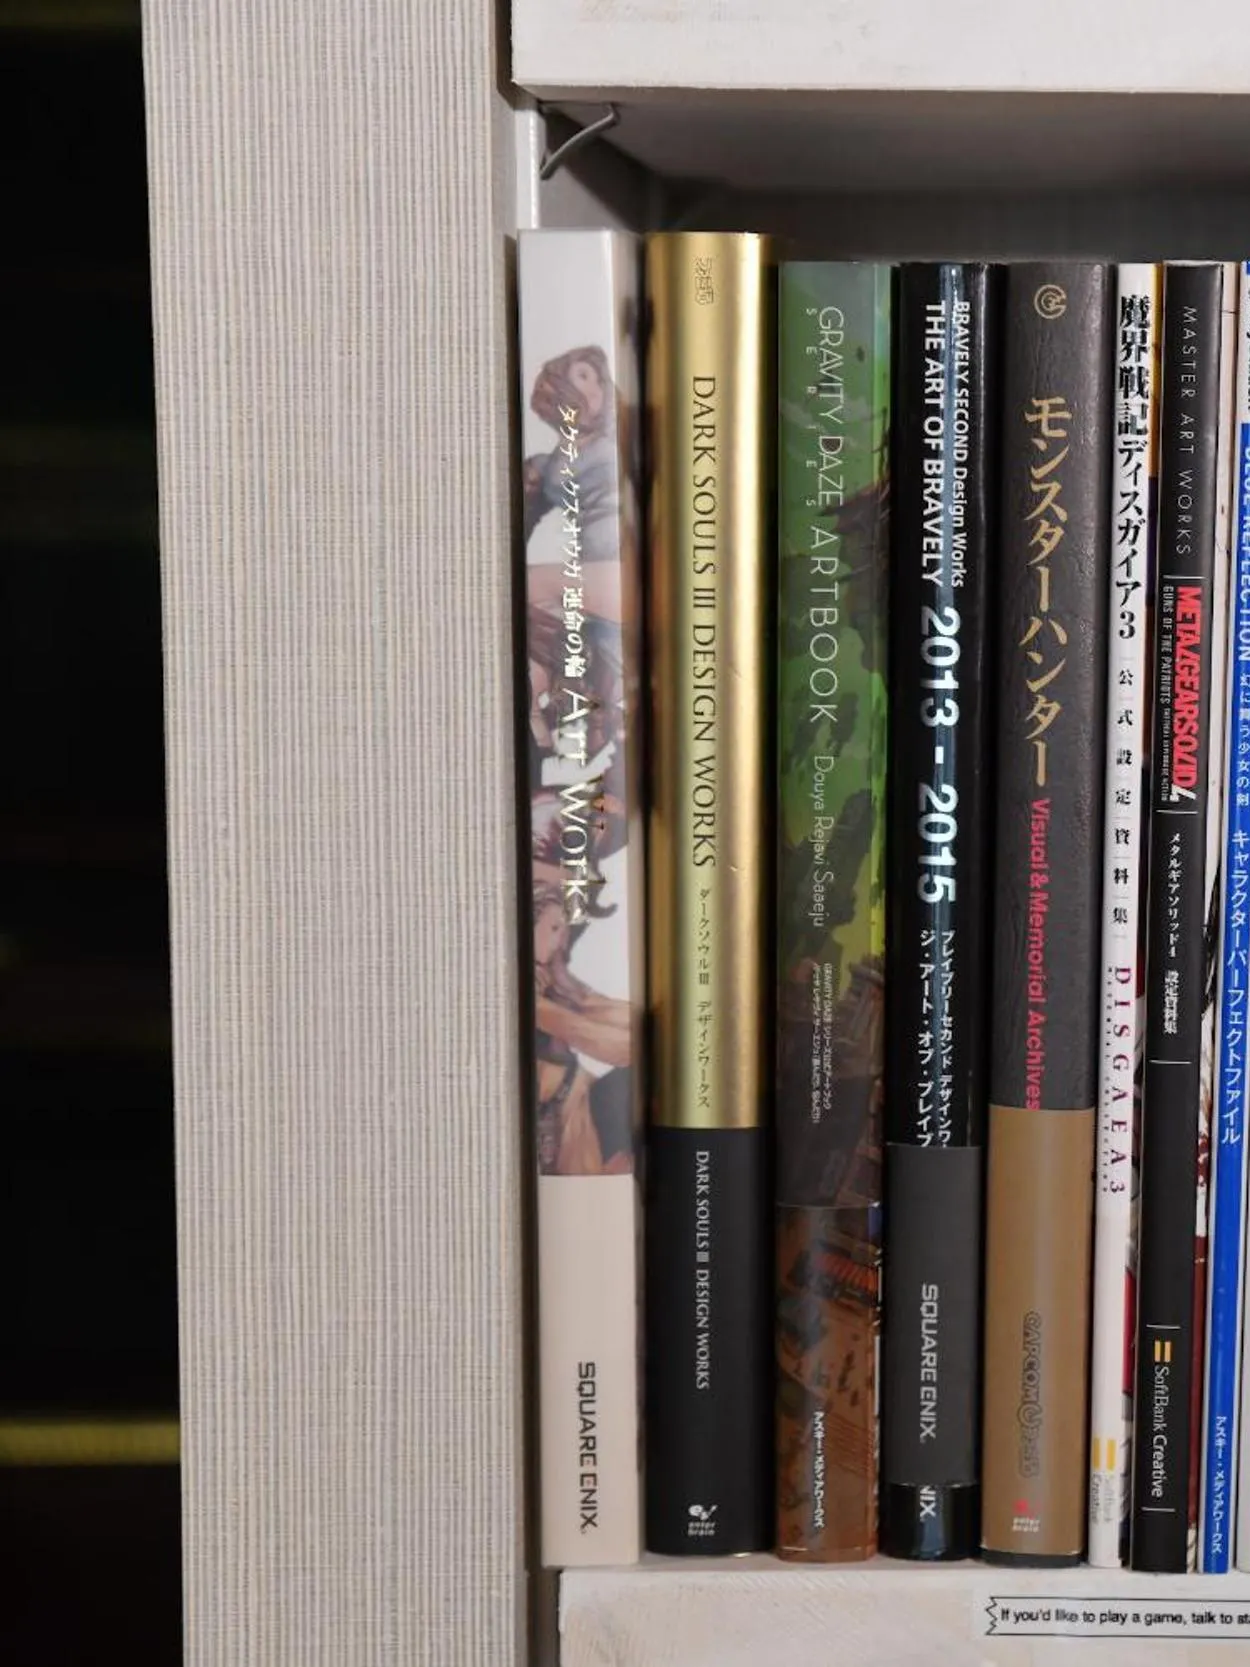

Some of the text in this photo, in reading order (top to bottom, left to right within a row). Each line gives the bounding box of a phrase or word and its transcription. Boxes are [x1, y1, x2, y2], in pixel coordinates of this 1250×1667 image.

[692, 376, 717, 465] DARK
[818, 305, 845, 507] GRAVITY DAZE
[921, 301, 946, 587] THE ART OF BRAVELY
[948, 301, 971, 588] BRAVELY SECOND Design Works
[1176, 305, 1198, 555] MASTER ART WORKS
[692, 474, 717, 575] SOULS
[1018, 396, 1073, 787] モンスターハンター
[1160, 585, 1174, 704] GUNS OF THE PATRIOTS
[692, 625, 717, 742] DESIGN
[919, 605, 962, 728] 2013
[692, 755, 717, 868] WORKS
[809, 755, 835, 811] Douya
[1029, 799, 1051, 871] Visual
[808, 815, 835, 866] Rejavi
[917, 783, 960, 904] 2015
[1027, 892, 1050, 1005] Memorial
[1024, 1012, 1047, 1110] Archives
[1109, 967, 1132, 1165] DISGAEA
[695, 1150, 710, 1196] DARK
[695, 1199, 711, 1249] SOULS
[695, 1269, 711, 1328] DESIGN
[695, 1333, 711, 1390] WORKS
[919, 1283, 939, 1440] SQUARE ENIX
[1021, 1309, 1043, 1405] CAPCOM
[577, 1361, 599, 1531] SQUARE ENIX
[1151, 1365, 1171, 1498] SoftBank Creative
[1001, 1609, 1010, 1621] If
[1013, 1609, 1051, 1625] you'd
[1055, 1609, 1078, 1622] like
[1083, 1610, 1096, 1623] to
[1099, 1611, 1128, 1626] play
[1132, 1614, 1141, 1624] a
[1144, 1614, 1188, 1627] game,
[1191, 1611, 1216, 1624] talk
[1219, 1612, 1233, 1625] to
